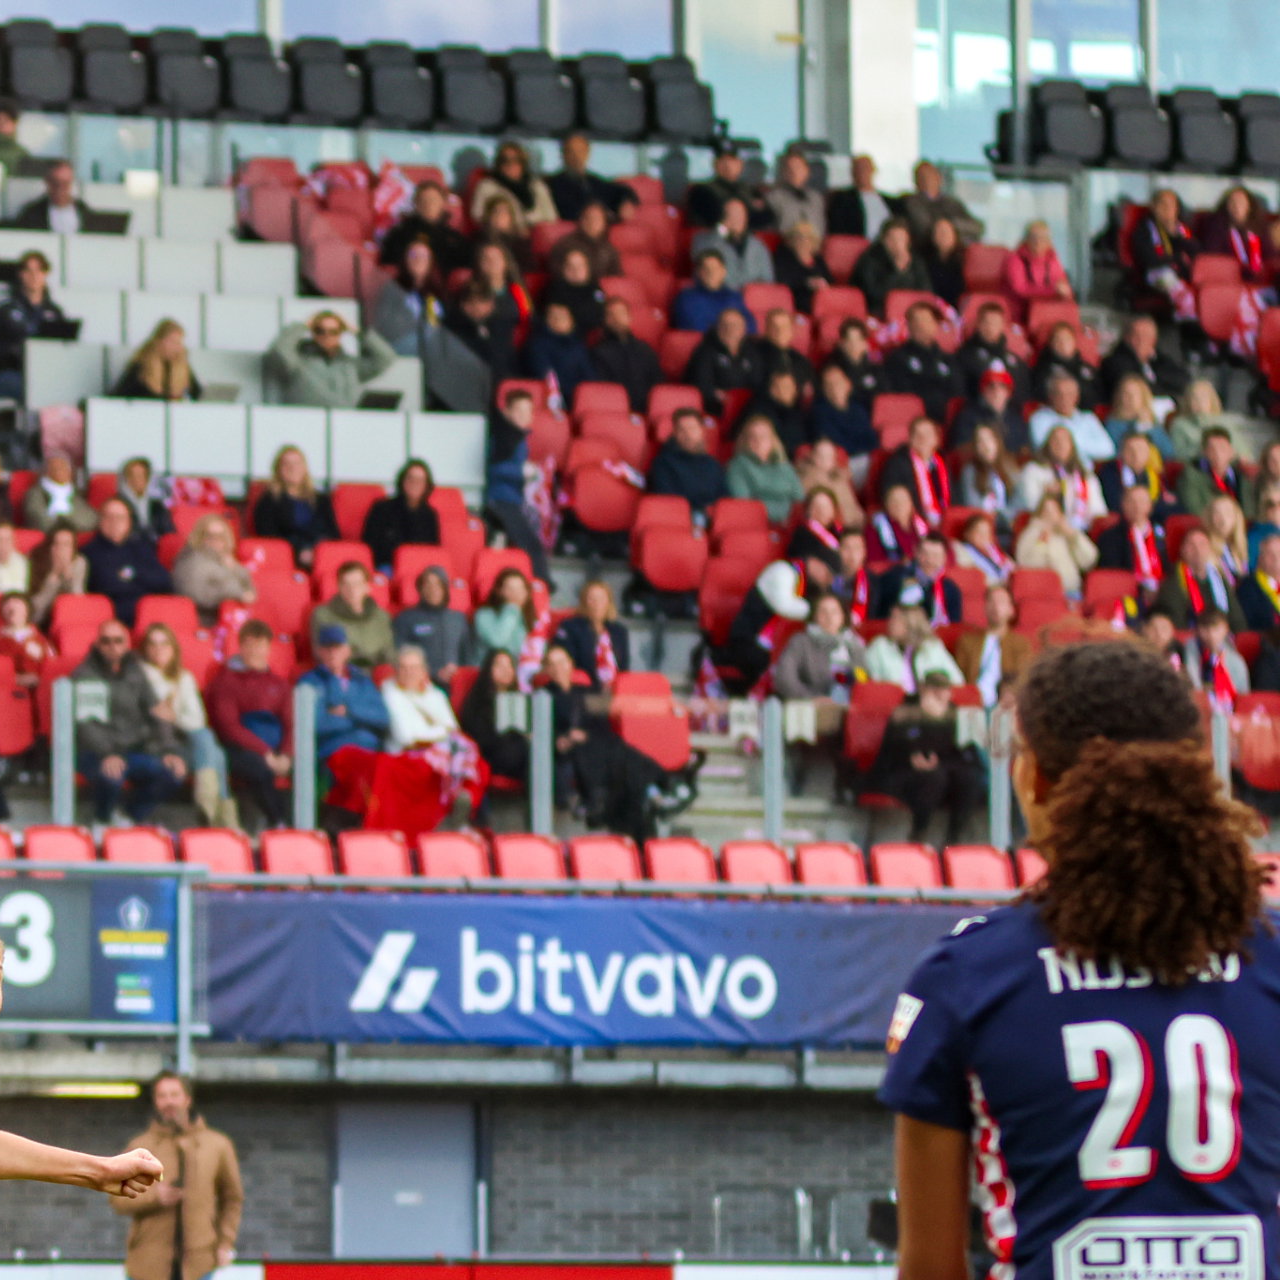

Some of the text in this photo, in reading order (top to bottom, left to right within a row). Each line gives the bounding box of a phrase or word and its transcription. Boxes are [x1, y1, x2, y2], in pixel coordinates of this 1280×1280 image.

[460, 926, 778, 1020] bitvavo
[1061, 1013, 1242, 1190] 20
[1081, 1236, 1242, 1267] OTTO
